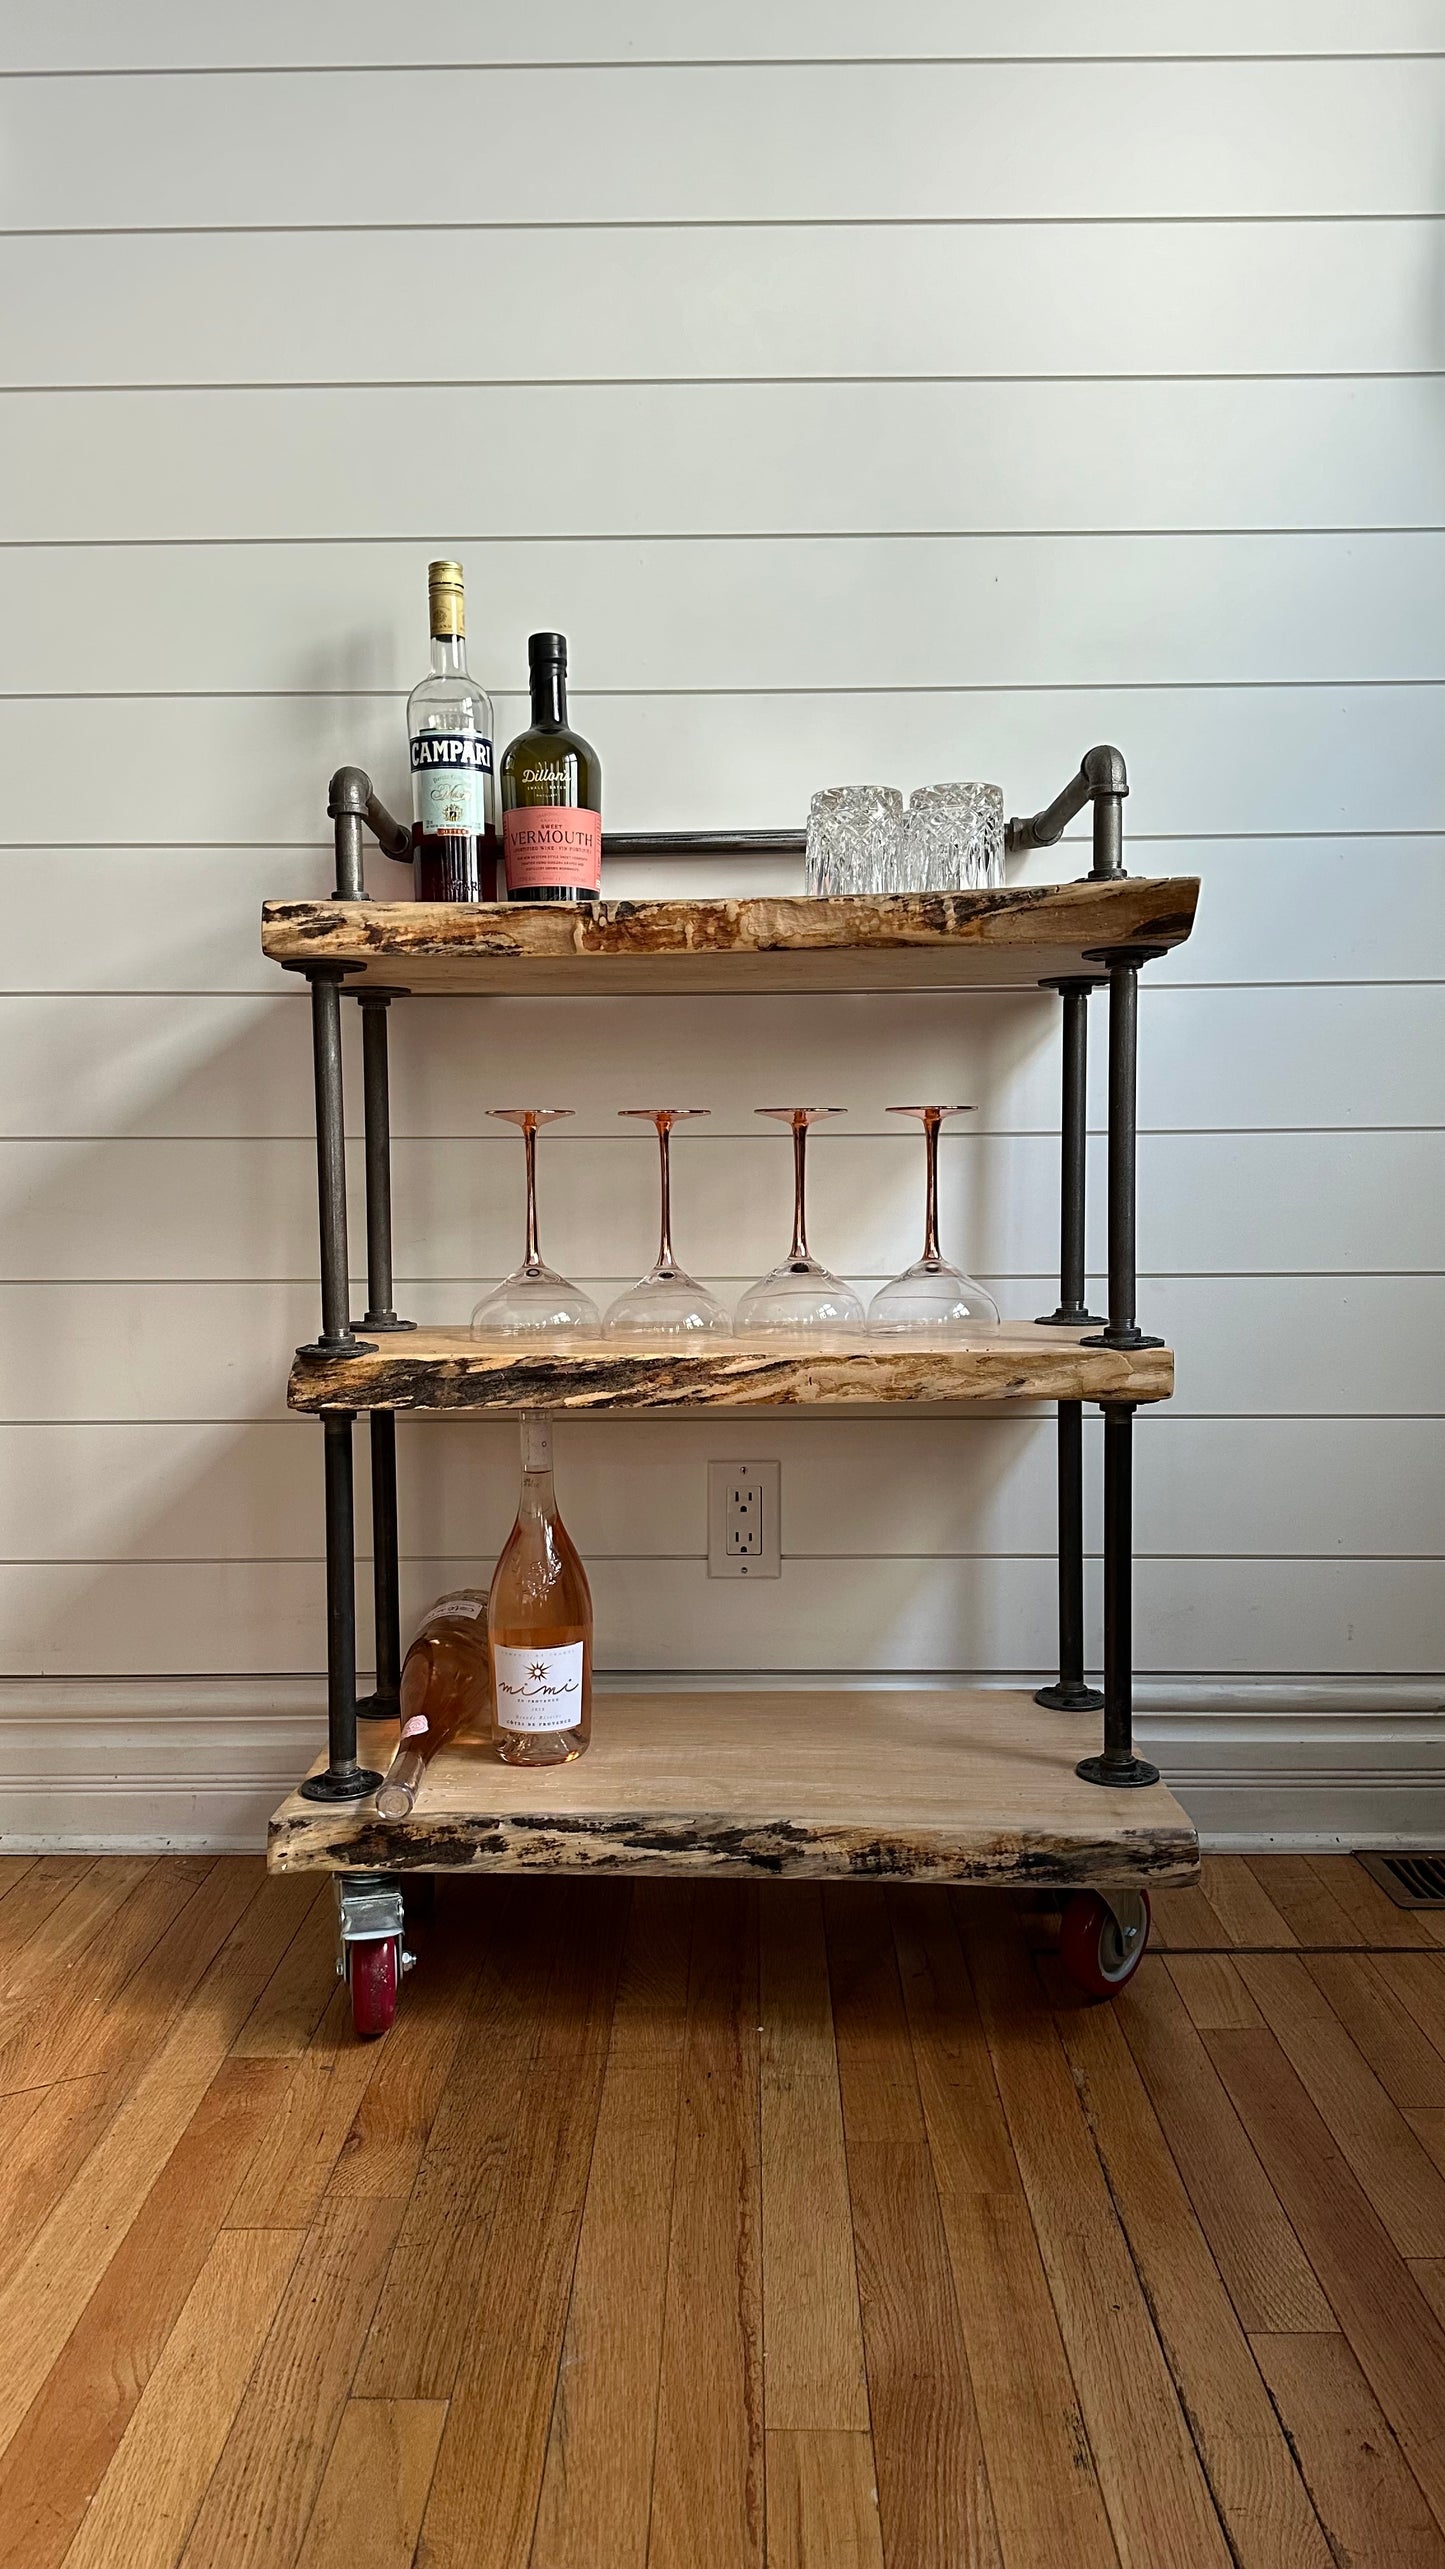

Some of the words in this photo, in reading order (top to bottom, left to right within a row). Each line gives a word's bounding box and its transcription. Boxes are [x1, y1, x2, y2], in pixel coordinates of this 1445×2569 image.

[411, 740, 491, 768] CAMPARI
[521, 769, 572, 783] Dillon's
[510, 830, 593, 847] VERMOUTH
[498, 1678, 579, 1696] mimi
